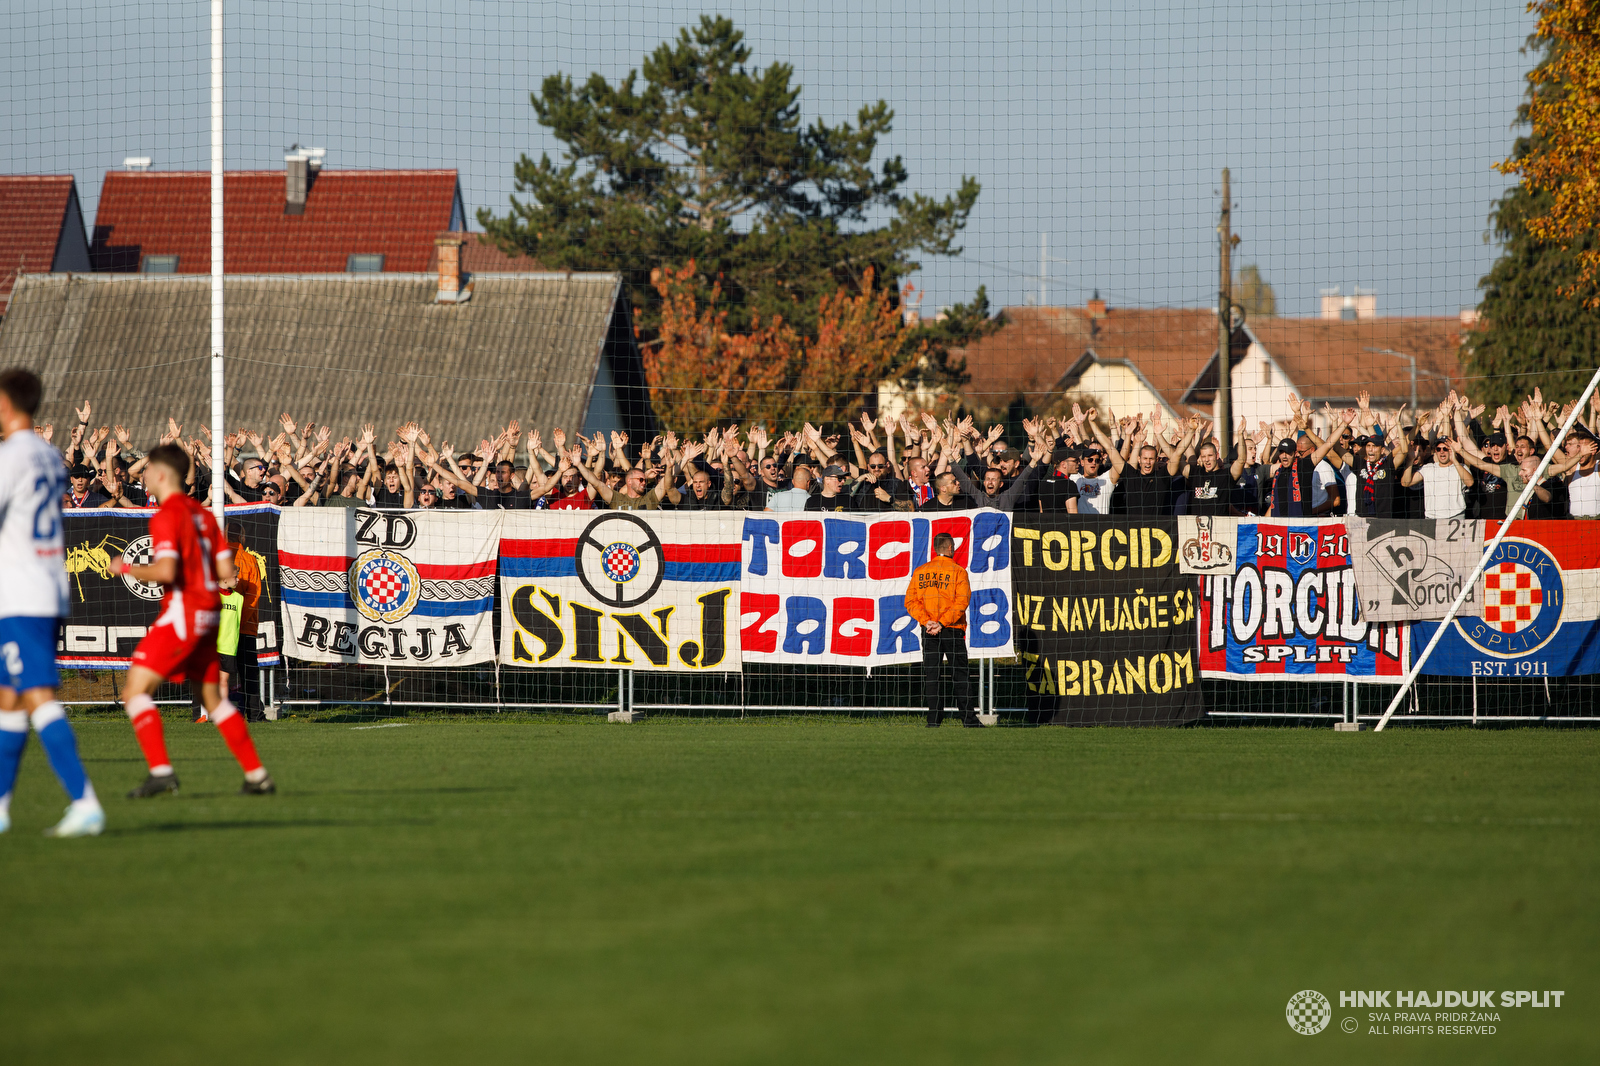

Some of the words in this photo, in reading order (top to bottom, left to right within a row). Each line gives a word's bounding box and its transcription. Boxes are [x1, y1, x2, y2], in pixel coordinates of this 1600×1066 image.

[355, 508, 417, 550] ZD
[1446, 519, 1477, 542] 2:1
[127, 539, 150, 558] HAJ
[605, 544, 637, 556] HAJDUK
[742, 512, 1010, 580] TORCIDA
[1014, 527, 1179, 571] TORCID
[1201, 532, 1210, 562] HNS
[363, 560, 406, 579] HAJDUK
[1490, 545, 1551, 575] JDUK
[607, 571, 631, 581] SPLIT
[919, 572, 950, 582] BOXER
[919, 580, 949, 590] SECURITY
[132, 583, 164, 597] SPLI
[365, 596, 399, 611] SPLIT
[1017, 592, 1045, 630] UZ
[1052, 588, 1168, 633] NAVIJAČE
[510, 585, 731, 669] SINJ
[740, 588, 1010, 656] ZAGRB
[297, 612, 472, 661] REGIJA
[1471, 625, 1541, 650] SPLIT
[1242, 645, 1357, 663] SPLIT
[1023, 648, 1194, 696] ZABRANOM
[1471, 661, 1510, 676] EST.
[1514, 661, 1549, 676] 1911
